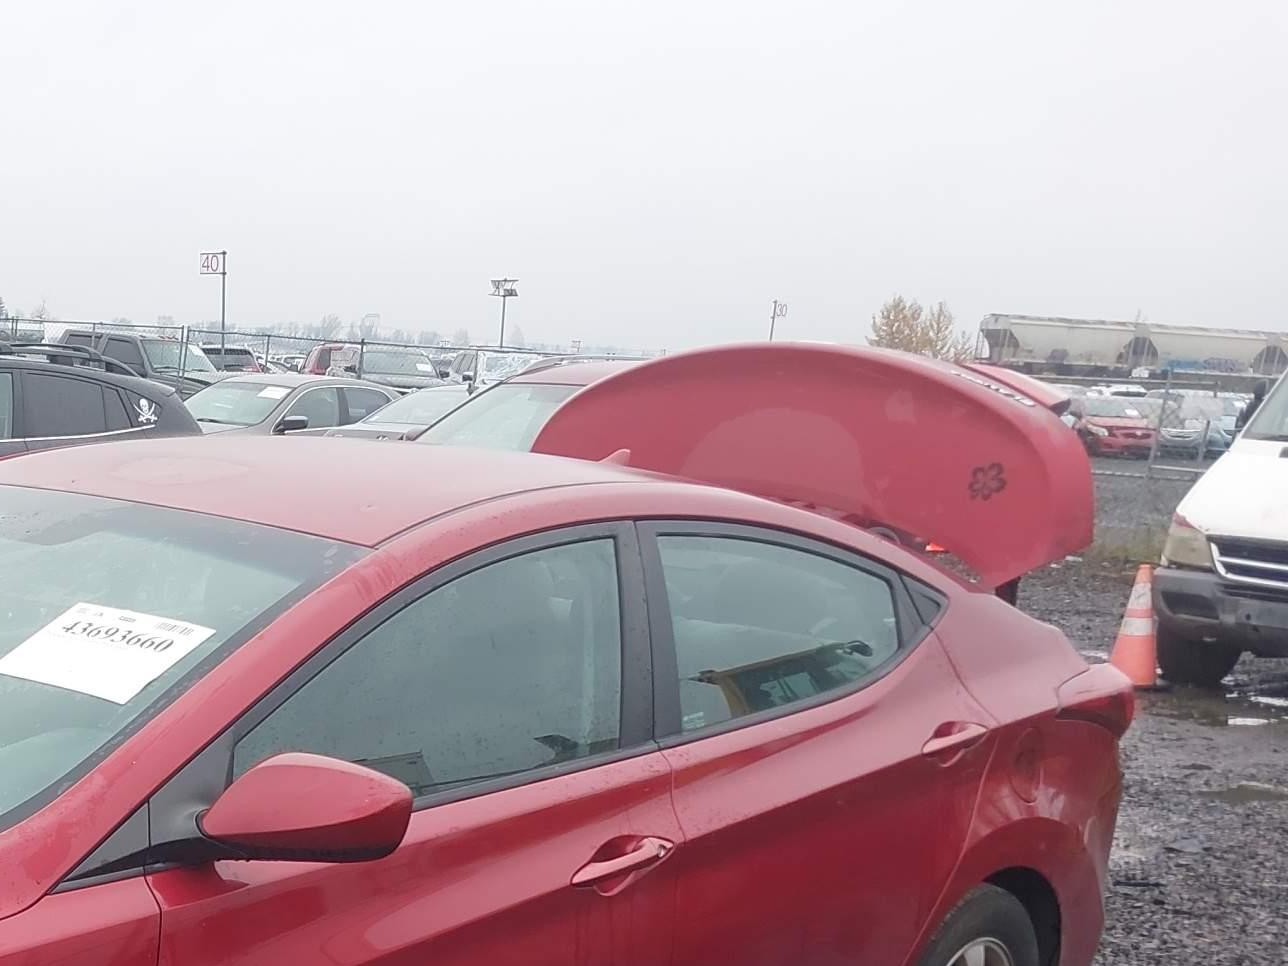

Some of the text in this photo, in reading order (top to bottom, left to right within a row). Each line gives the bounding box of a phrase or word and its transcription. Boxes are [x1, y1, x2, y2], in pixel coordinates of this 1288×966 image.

[202, 255, 219, 272] 40
[776, 303, 788, 317] 30
[62, 620, 175, 653] 43693660
